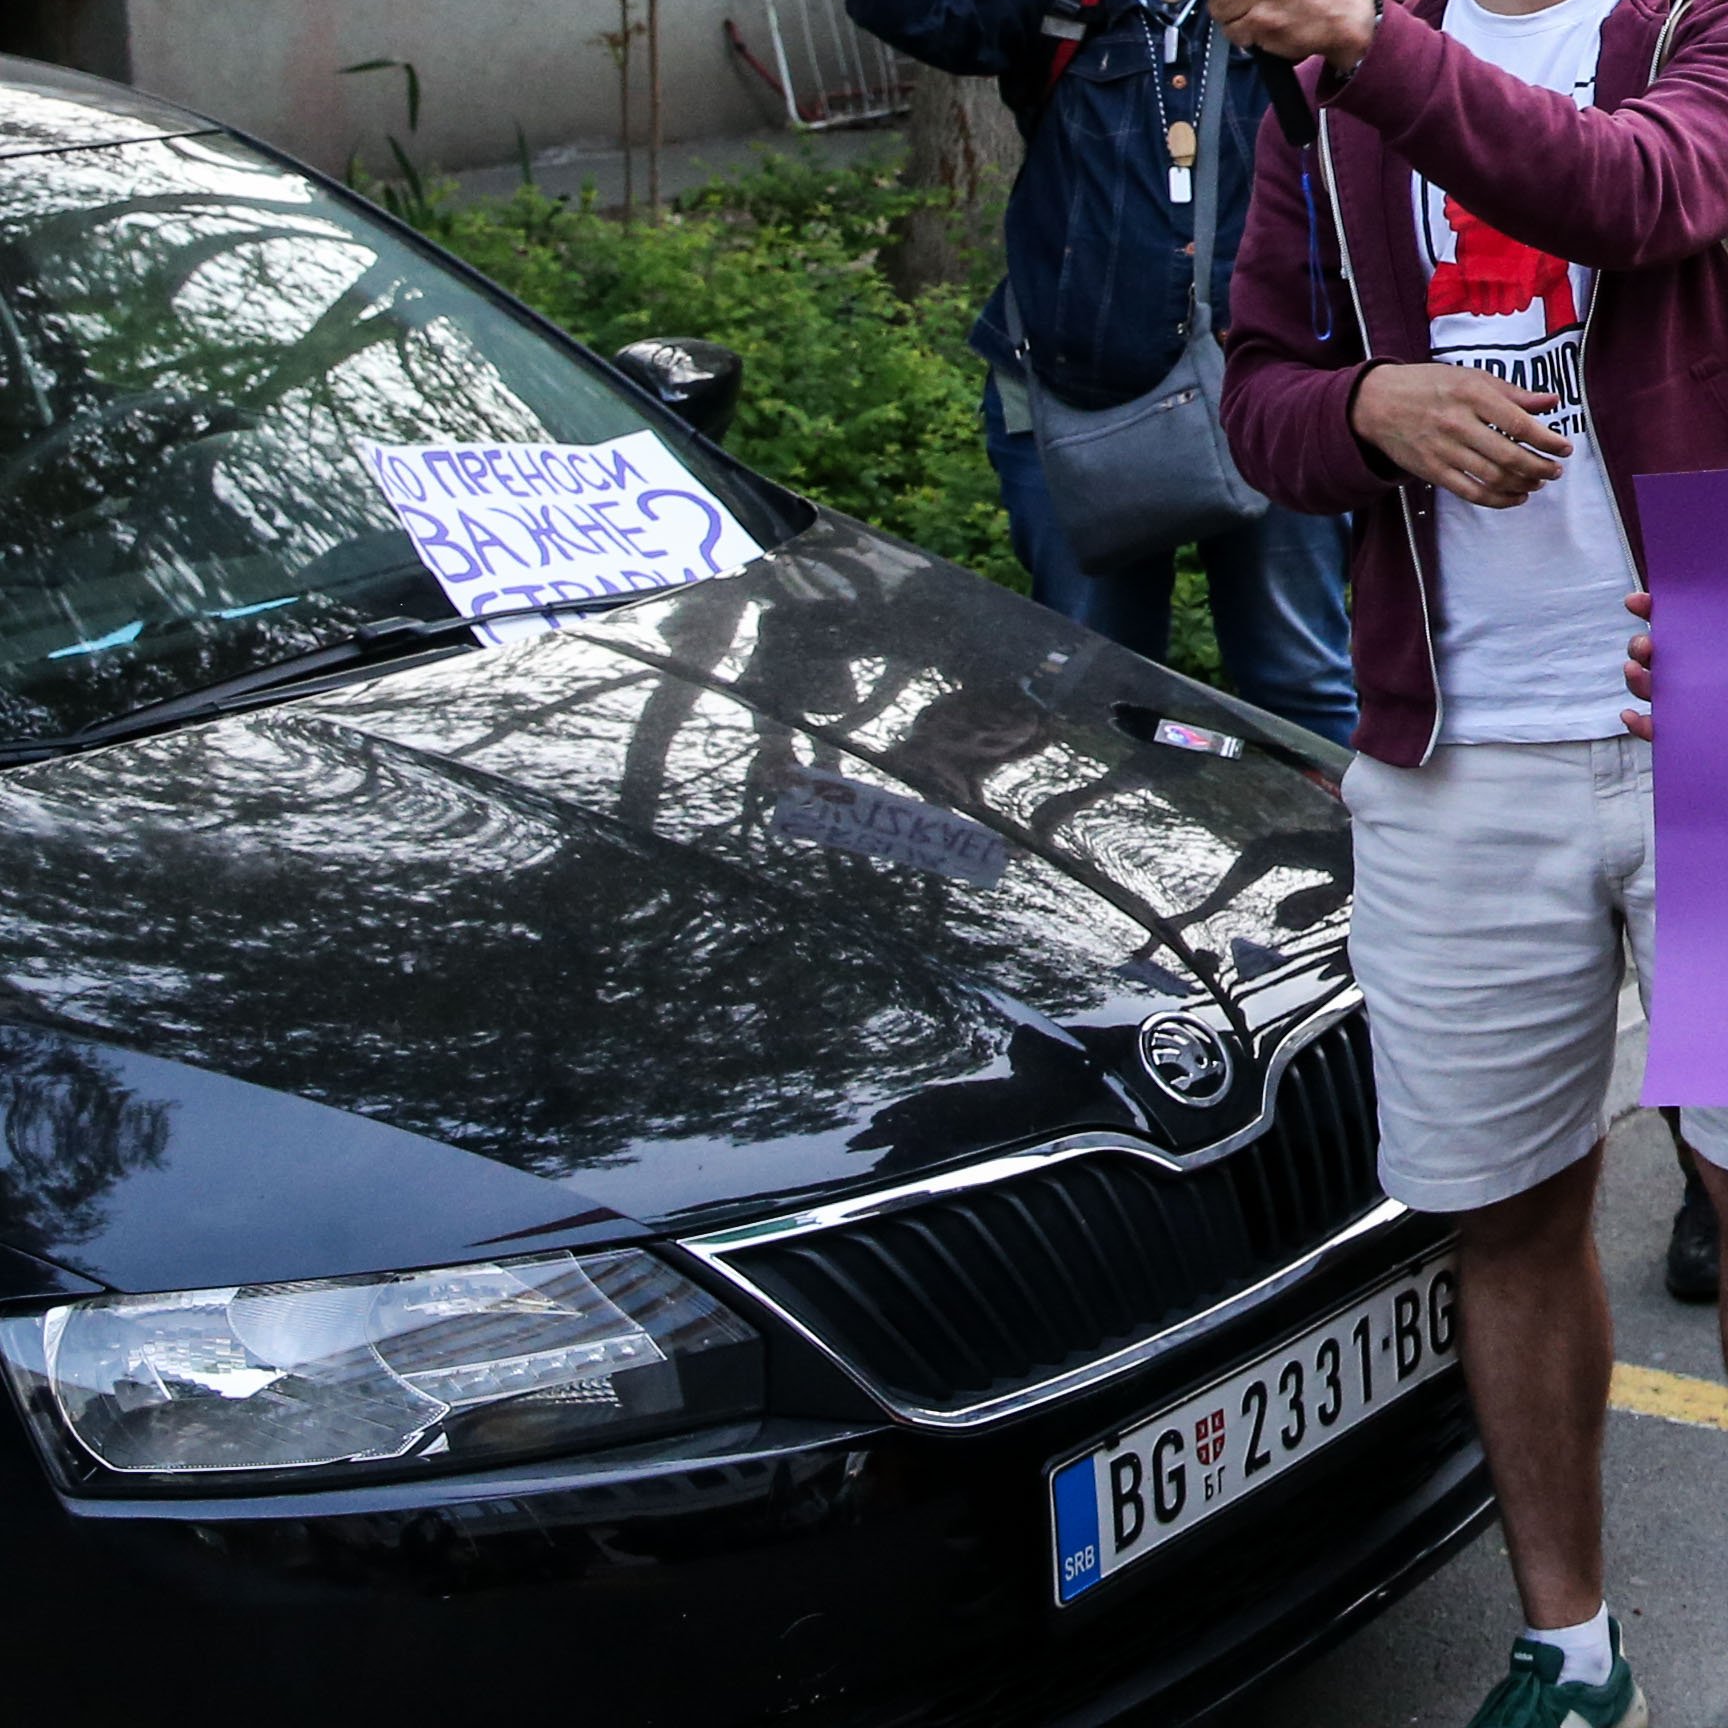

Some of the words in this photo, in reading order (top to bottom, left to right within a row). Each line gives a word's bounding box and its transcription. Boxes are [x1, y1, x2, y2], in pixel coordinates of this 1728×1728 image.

[370, 446, 427, 502] КО
[422, 446, 650, 501] ПРЕНОСИ
[1109, 1429, 1187, 1554] BG
[1203, 1465, 1226, 1502] БГ
[1064, 1545, 1096, 1581] SRB
